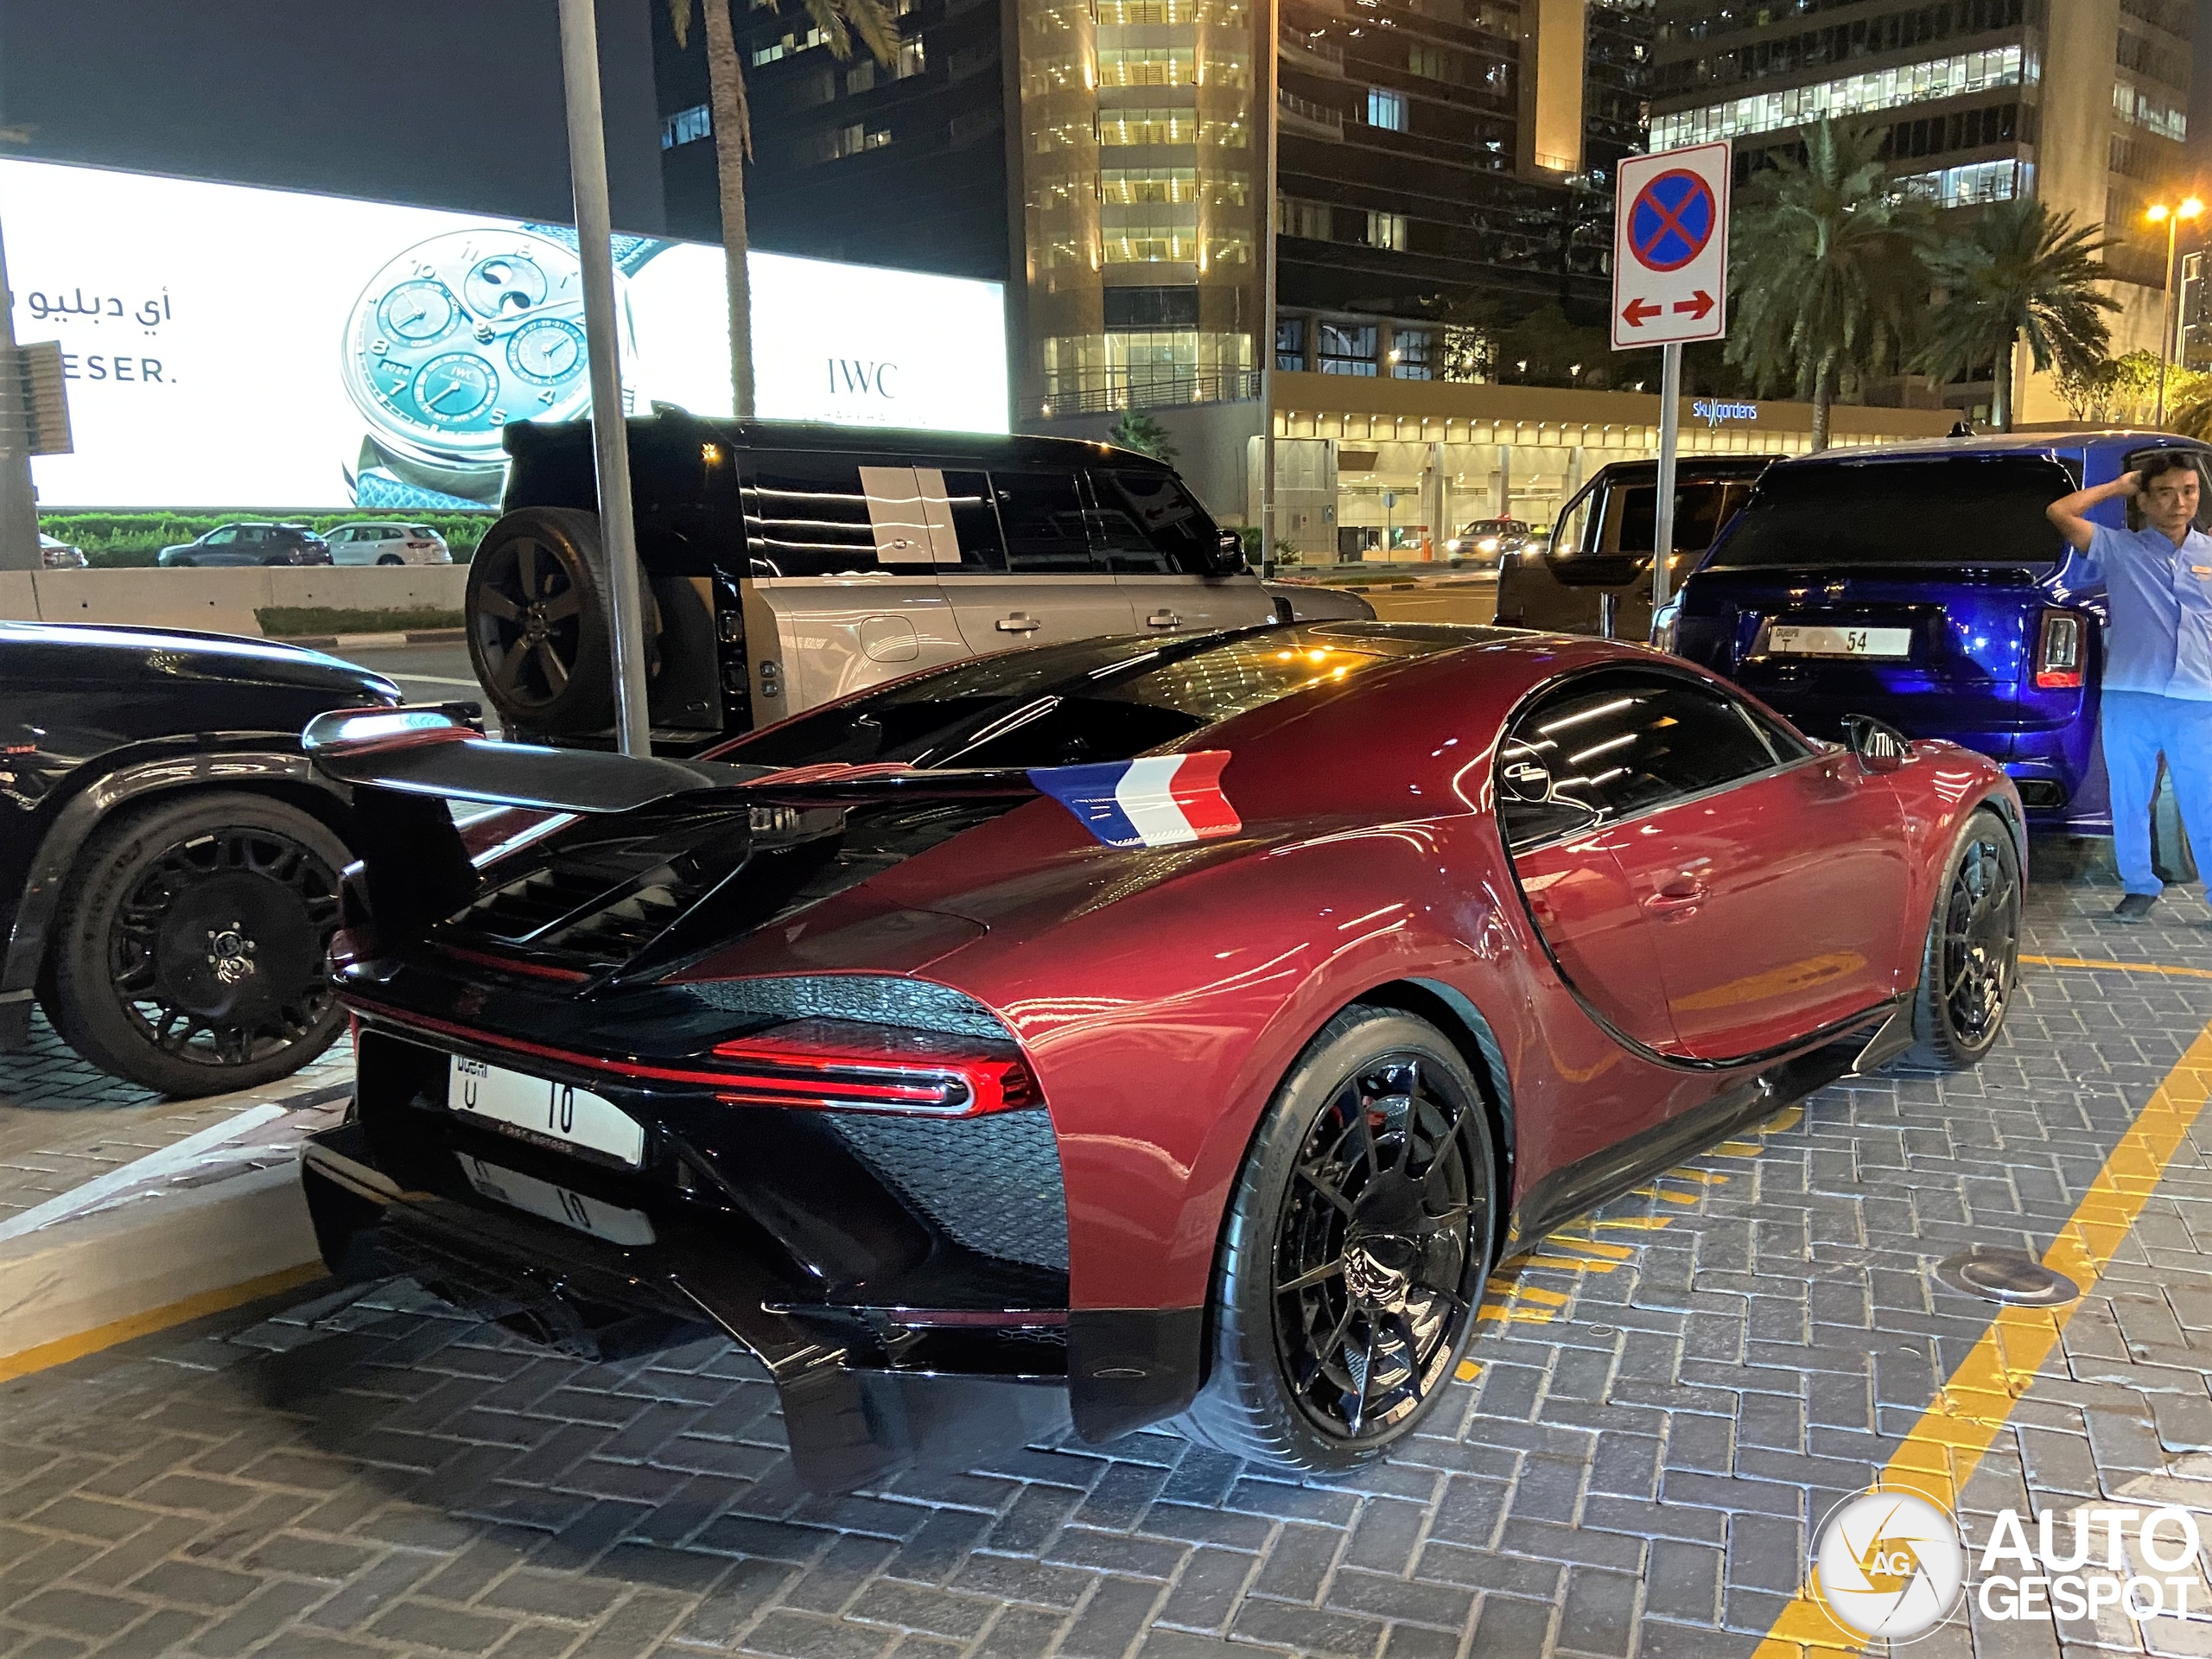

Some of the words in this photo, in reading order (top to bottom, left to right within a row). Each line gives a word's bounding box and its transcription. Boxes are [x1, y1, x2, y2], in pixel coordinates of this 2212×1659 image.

[29, 288, 124, 325] دبليو
[135, 285, 171, 336] أي
[381, 361, 410, 376] 2024
[827, 359, 898, 398] IWC
[389, 378, 408, 397] 7
[537, 388, 556, 407] 4
[1847, 632, 1867, 652] 54
[549, 1082, 573, 1134] 10
